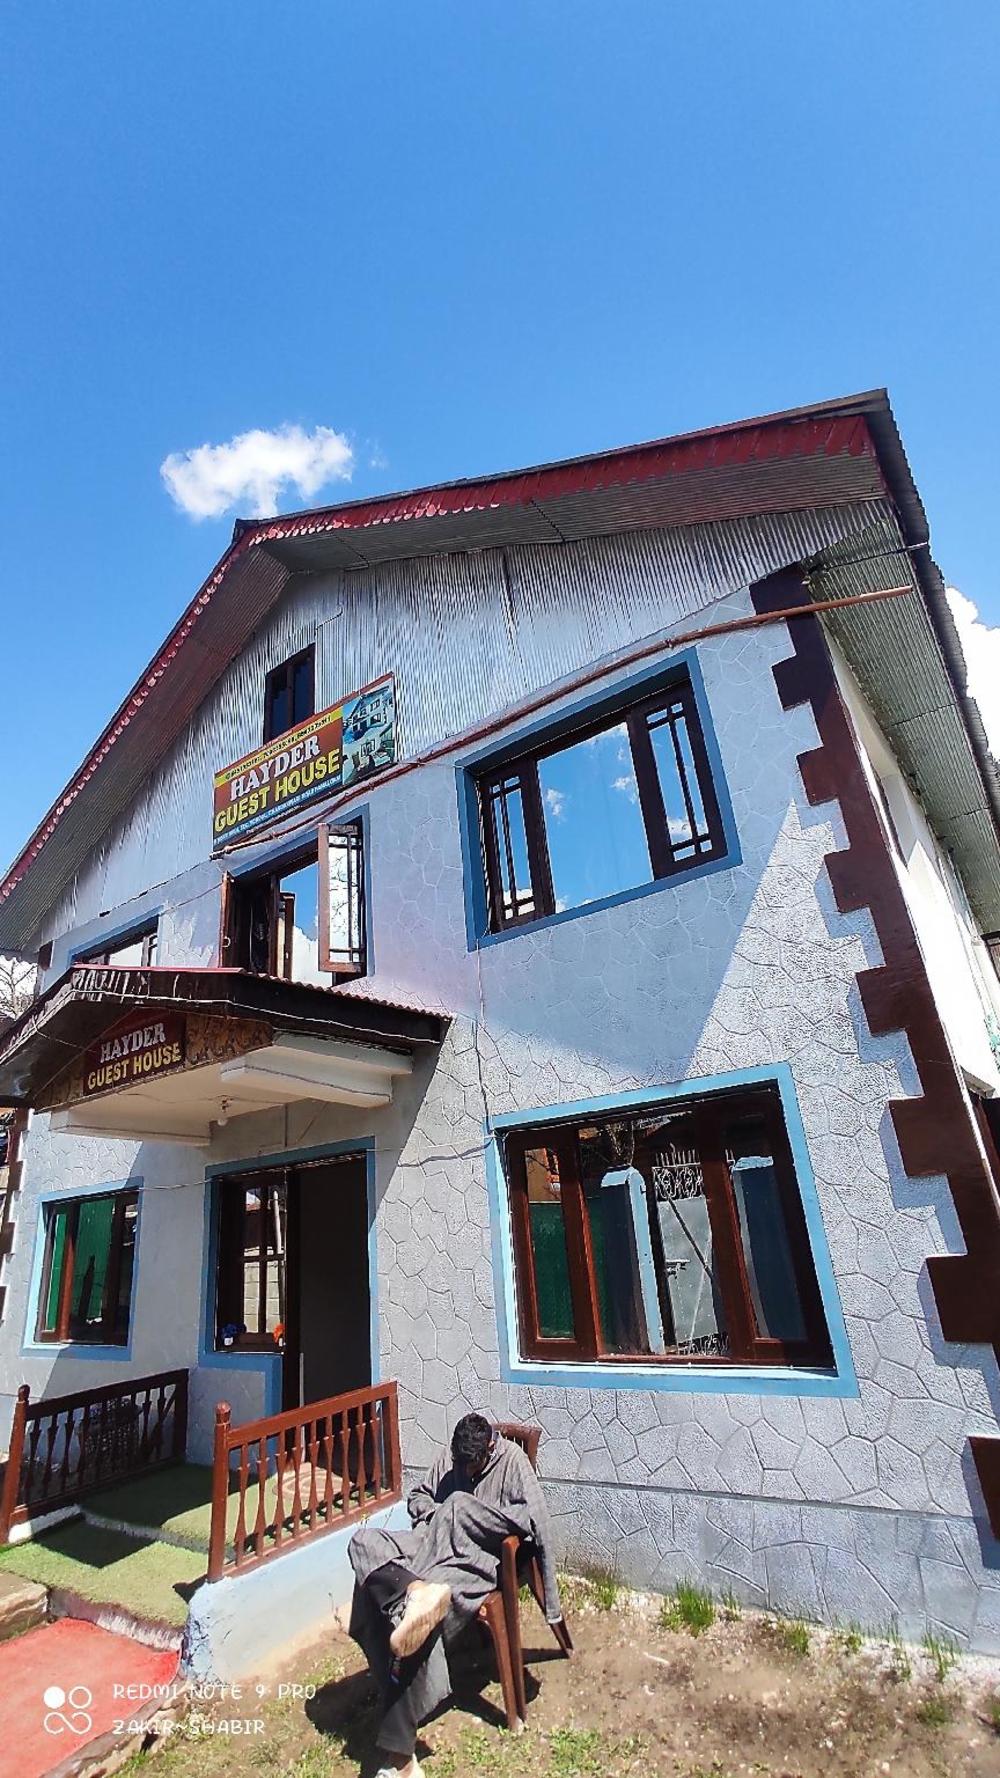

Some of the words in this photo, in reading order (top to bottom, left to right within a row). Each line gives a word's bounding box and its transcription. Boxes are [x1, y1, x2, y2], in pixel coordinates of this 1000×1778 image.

[214, 785, 270, 832] GUEST
[274, 749, 340, 802] HOUSE
[230, 735, 321, 801] HAYDER
[87, 1058, 129, 1089] GUEST
[133, 1042, 181, 1075] HOUSE
[100, 1022, 166, 1063] HAYDER
